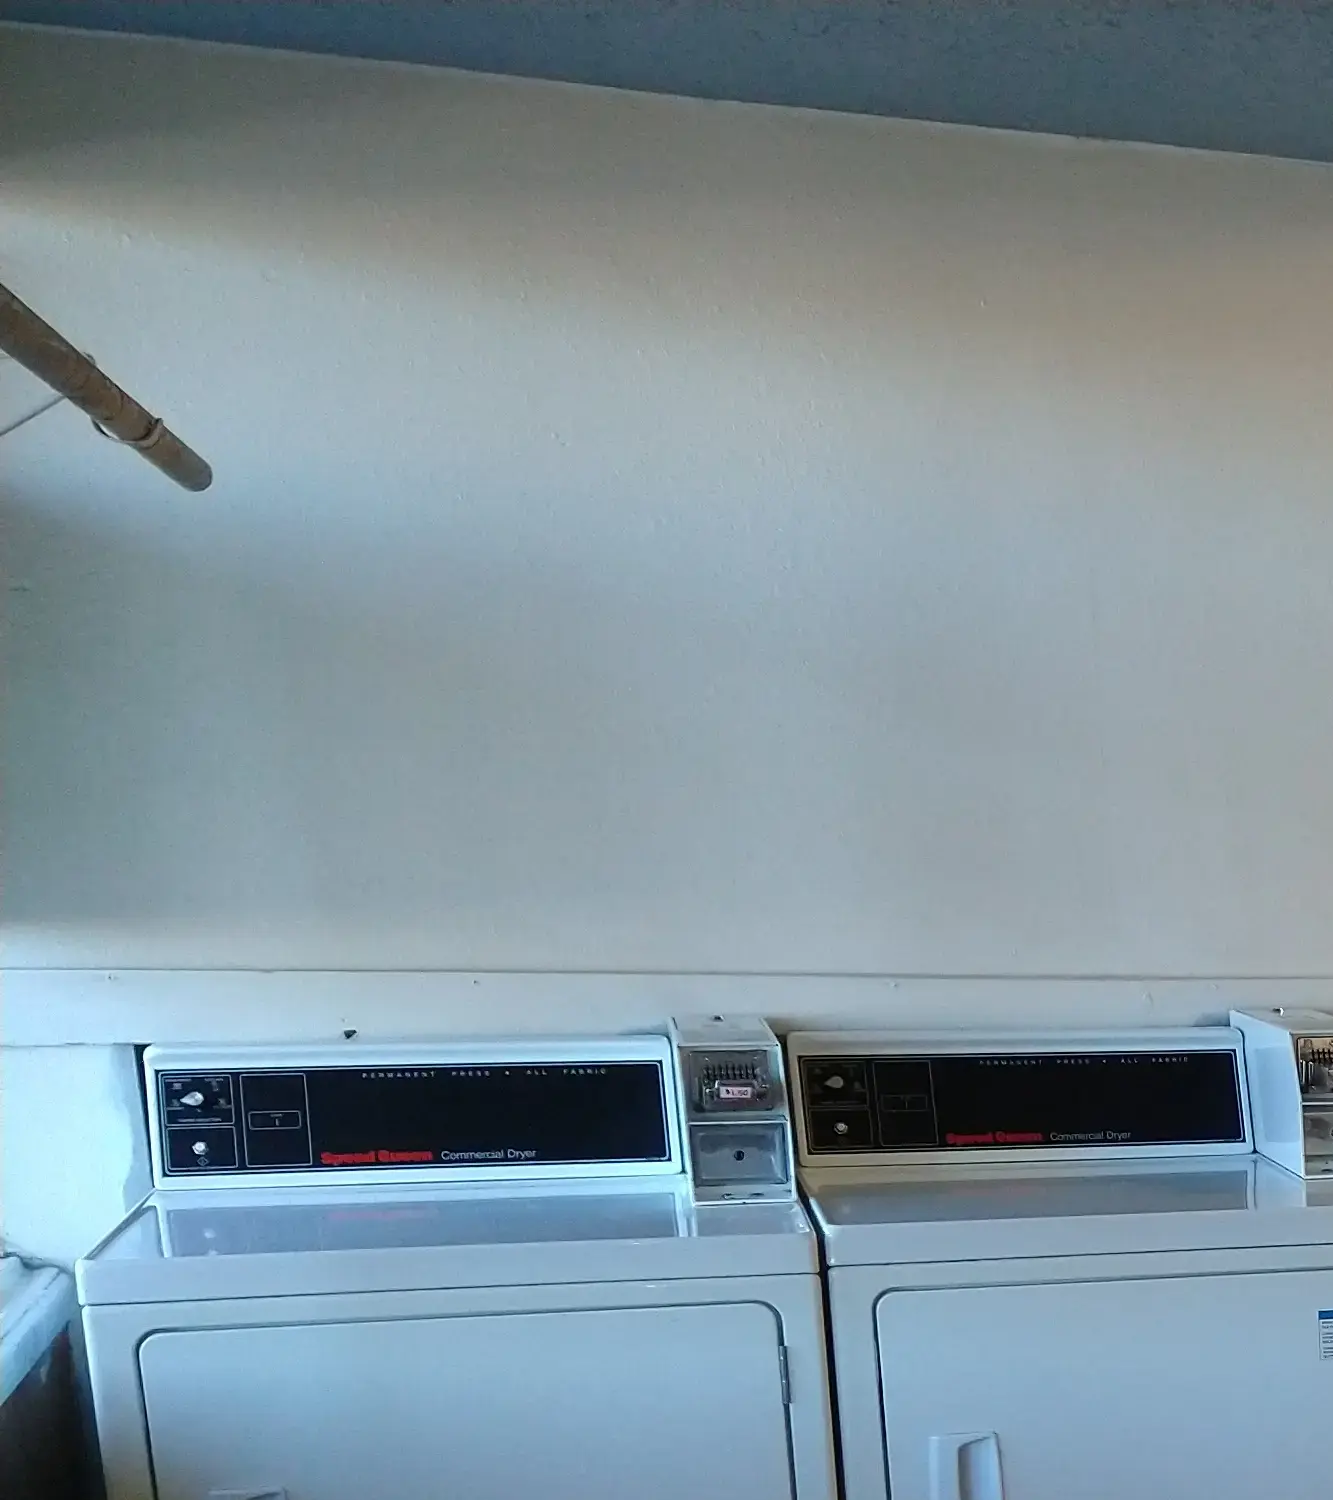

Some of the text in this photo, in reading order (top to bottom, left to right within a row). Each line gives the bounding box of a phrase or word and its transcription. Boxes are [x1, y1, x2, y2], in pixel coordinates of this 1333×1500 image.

[1050, 1131, 1104, 1141] Commercial
[1106, 1130, 1132, 1141] Dryer
[440, 1149, 504, 1161] Commercial
[507, 1148, 537, 1160] Dryer
